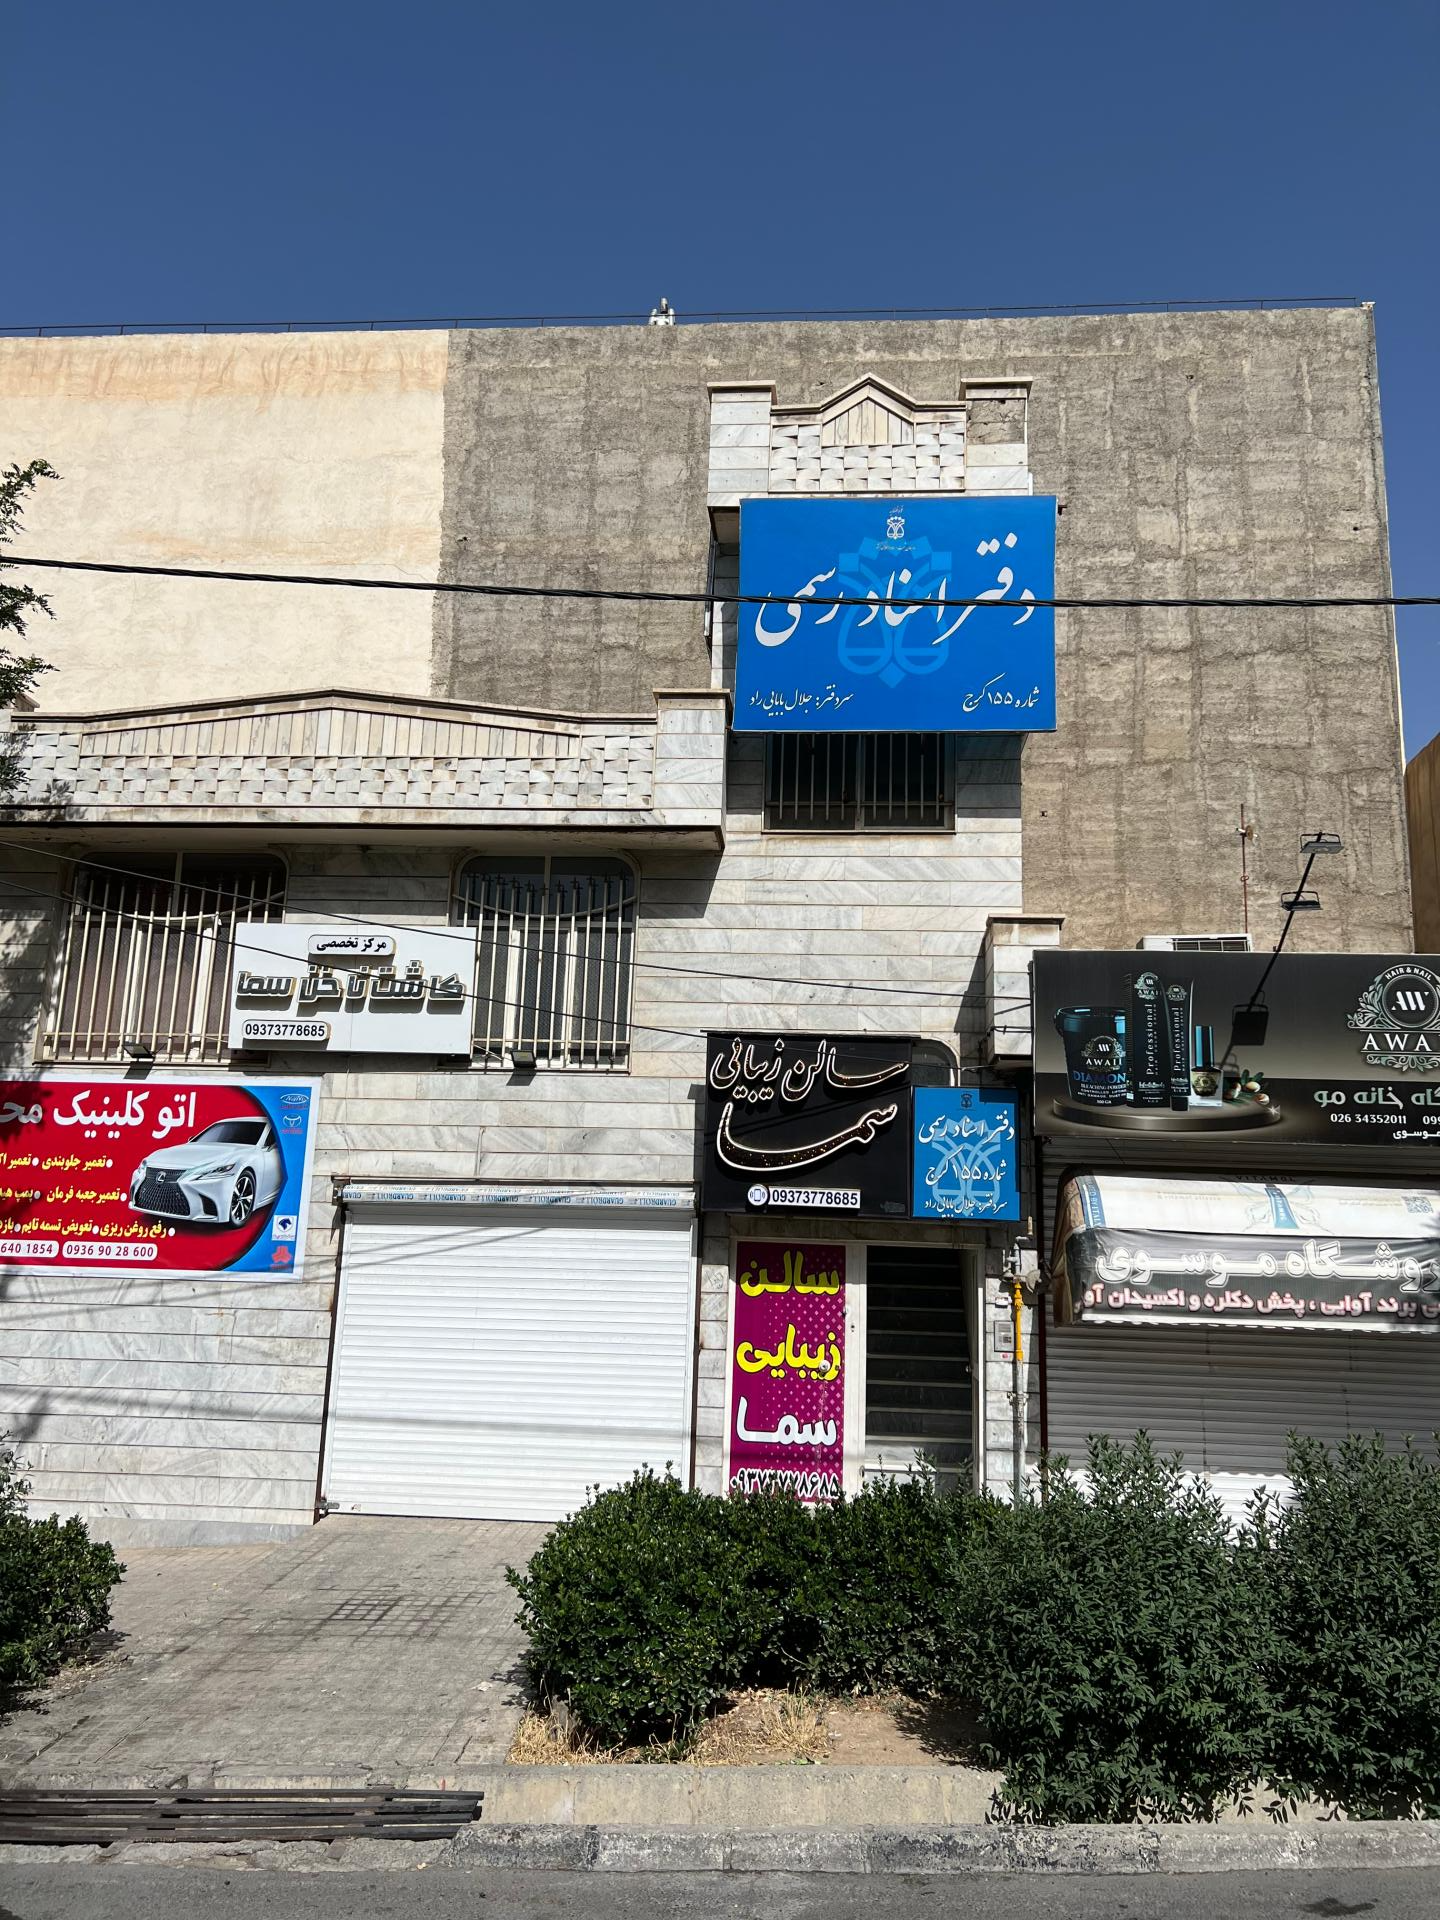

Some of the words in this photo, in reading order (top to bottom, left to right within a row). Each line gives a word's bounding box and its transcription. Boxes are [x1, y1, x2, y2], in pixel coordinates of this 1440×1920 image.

[858, 568, 946, 627] اسناد
[932, 532, 1035, 645] دفتر
[755, 567, 843, 647] رسمی
[788, 688, 812, 713] جلال
[962, 672, 1006, 712] کرج
[987, 691, 1012, 705] ۱۵۵
[1015, 686, 1039, 708] شماره
[316, 937, 359, 951] تخصصی
[361, 937, 387, 952] مرکز
[236, 971, 296, 997] سما
[1385, 967, 1405, 980] HAIR
[1413, 967, 1432, 981] NAIL
[245, 1023, 326, 1038] 09373778685
[1145, 1004, 1154, 1075] Professional
[1172, 1007, 1182, 1071] Professional
[781, 1039, 910, 1101] سالن
[1314, 1090, 1346, 1108] مو
[1353, 1086, 1403, 1110] خانه
[53, 1090, 150, 1139] کلینیک
[151, 1091, 197, 1139] اتو
[1330, 1113, 1351, 1123] 026
[1355, 1113, 1407, 1124] 34352011
[716, 1101, 898, 1172] سما
[918, 1115, 948, 1143] رسمی
[952, 1117, 985, 1138] اسناد
[981, 1110, 1015, 1144] دفتر
[7, 1153, 32, 1170] تعمیر
[41, 1154, 81, 1171] جلوبندی
[82, 1154, 107, 1171] تعمیر
[926, 1145, 965, 1185] کرج
[983, 1160, 1007, 1180] شماره
[952, 1165, 982, 1180] ۱۵۵
[46, 1185, 74, 1203] فرمان
[76, 1190, 96, 1203] جعبه
[96, 1188, 121, 1204] تعمیر
[771, 1190, 859, 1206] 09373778685
[955, 1196, 975, 1216] جلال
[21, 1217, 39, 1234] تایم
[40, 1218, 62, 1232] تسمه
[61, 1220, 94, 1236] تعویض
[100, 1221, 124, 1237] ریزی
[124, 1220, 149, 1238] روغن
[149, 1220, 167, 1238] رفع
[26, 1243, 53, 1254] 1854
[66, 1244, 94, 1255] 0936
[98, 1245, 111, 1256] 90
[115, 1245, 129, 1256] 28
[133, 1246, 154, 1257] 600
[740, 1250, 840, 1297] سالن
[1096, 1246, 1278, 1287] موسوی
[1108, 1287, 1185, 1309] اکسیدان
[1189, 1294, 1201, 1312] و
[1203, 1289, 1254, 1312] دکلره
[1257, 1290, 1305, 1318] پخش
[1320, 1291, 1373, 1316] آوایی
[1376, 1297, 1418, 1318] برند
[736, 1323, 841, 1381] زیبایی
[736, 1396, 837, 1446] سما
